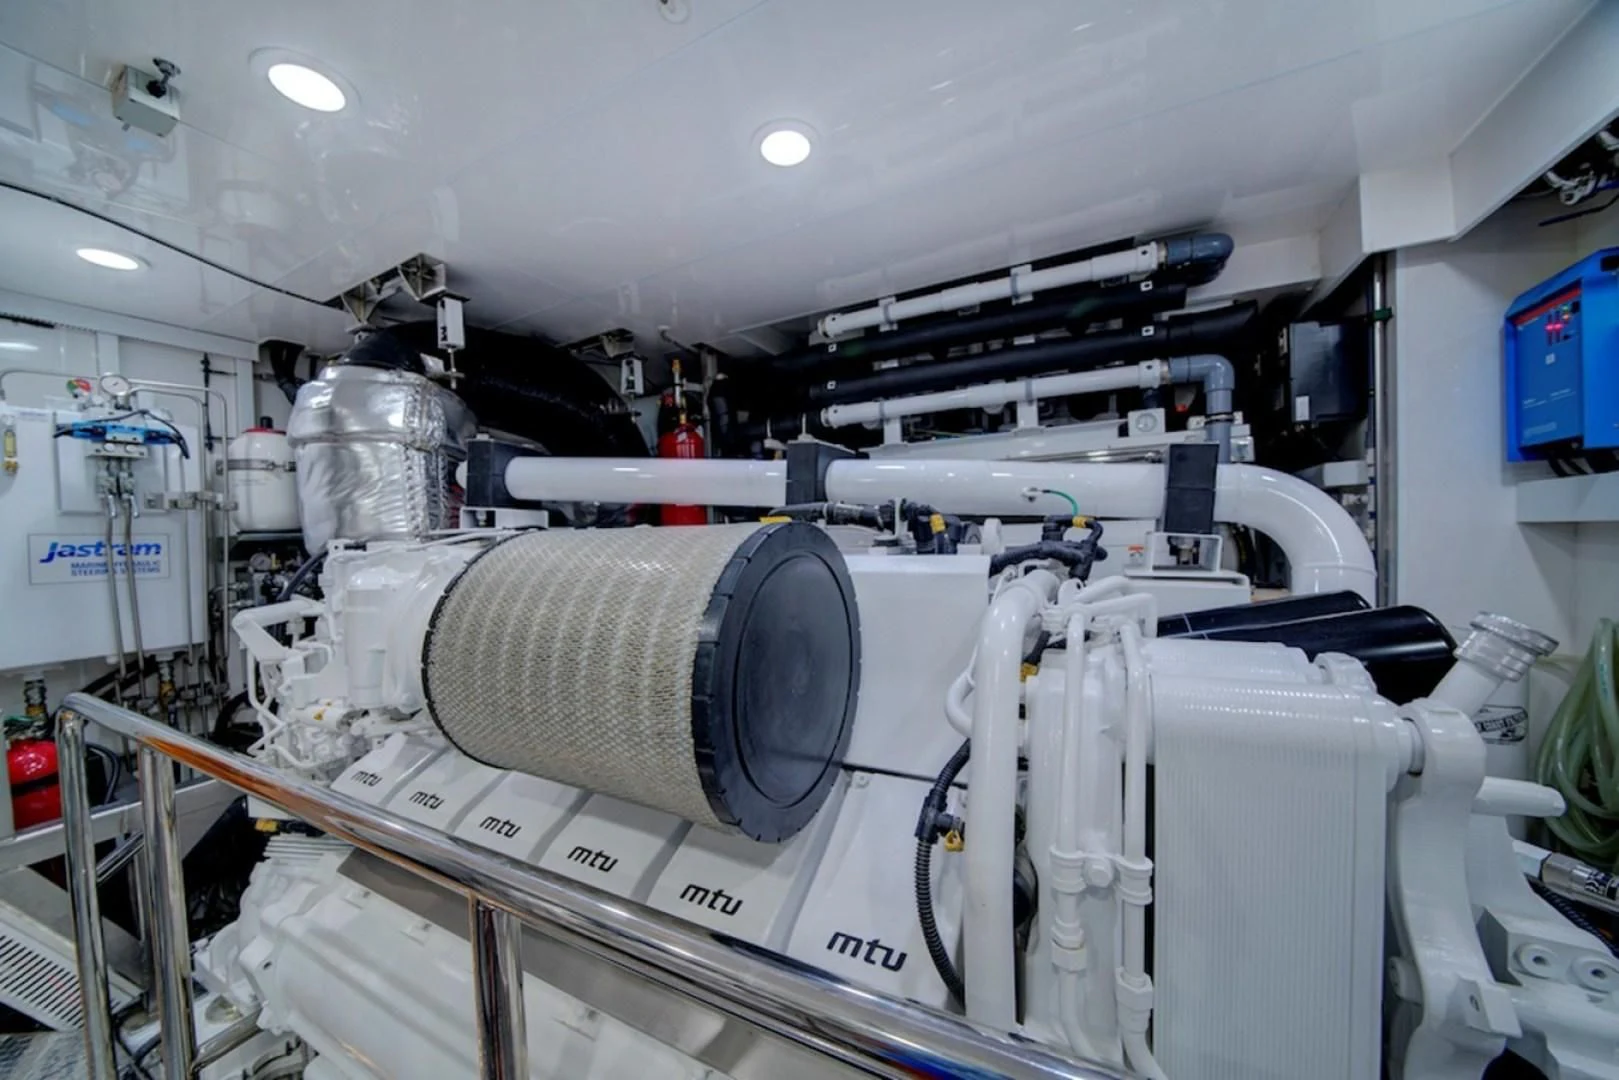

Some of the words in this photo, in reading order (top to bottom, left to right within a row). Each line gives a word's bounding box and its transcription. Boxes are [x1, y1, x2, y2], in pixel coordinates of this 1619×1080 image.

[40, 541, 161, 563] Jastram
[351, 769, 382, 787] mtu
[409, 791, 444, 810] mtu
[479, 816, 522, 839] mtu
[567, 846, 619, 873] mtu
[680, 883, 744, 916] mtu
[826, 931, 908, 973] mtu
